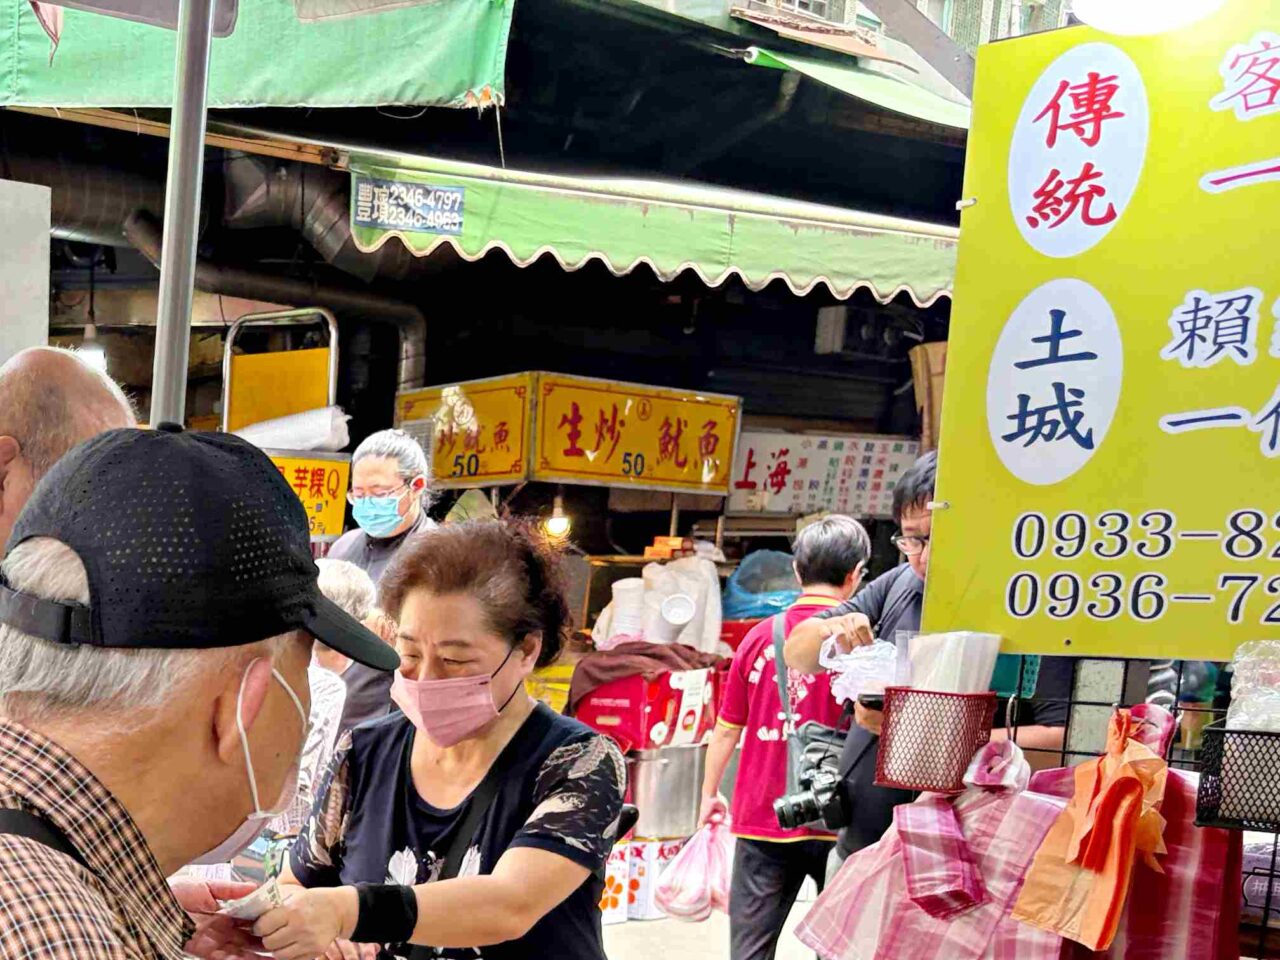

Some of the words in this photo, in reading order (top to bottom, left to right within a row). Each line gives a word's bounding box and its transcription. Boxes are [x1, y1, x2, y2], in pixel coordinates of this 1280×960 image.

[1026, 72, 1125, 229] 傳統
[389, 186, 461, 211] 2346-4797
[1170, 295, 1254, 361] 賴
[1001, 309, 1098, 450] 土城
[437, 421, 510, 459] 炒魷魚
[452, 454, 480, 477] 50
[622, 452, 645, 476] 50
[735, 448, 792, 495] 上海
[1014, 511, 1280, 559] 0933-8
